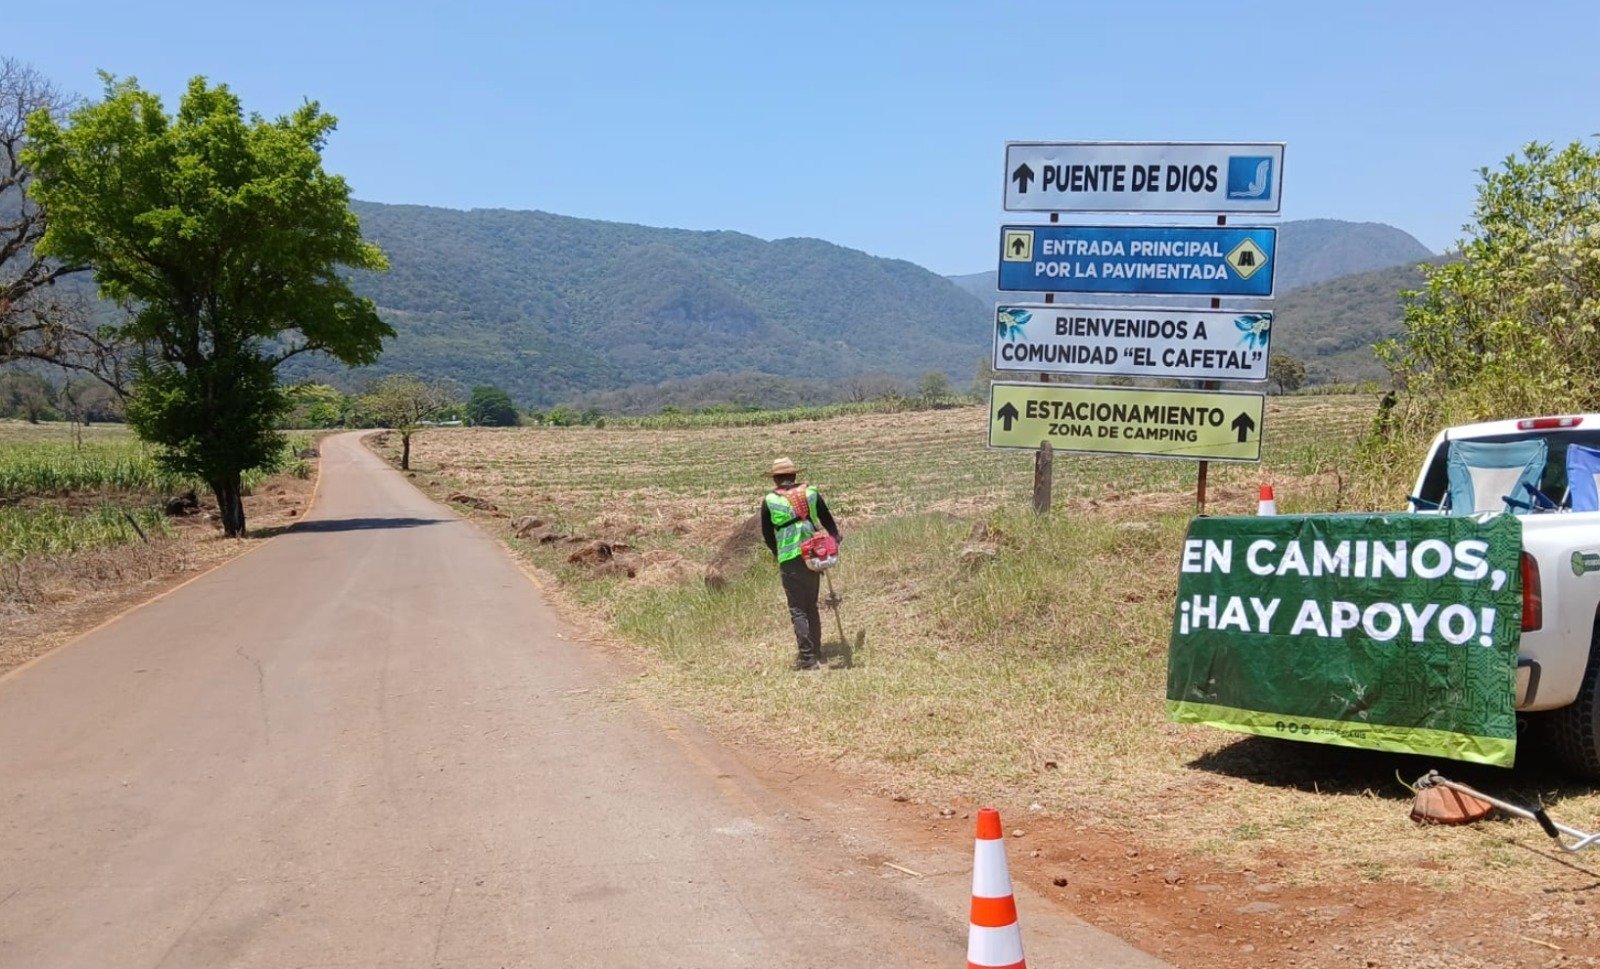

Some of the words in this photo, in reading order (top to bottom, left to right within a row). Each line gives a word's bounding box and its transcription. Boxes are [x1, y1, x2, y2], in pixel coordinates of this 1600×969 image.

[1042, 165, 1125, 192] PUENTE
[1131, 165, 1160, 192] DE
[1166, 165, 1218, 193] DIOS
[1043, 239, 1125, 256] ENTRADA
[1130, 241, 1223, 257] PRINCIPAL
[1035, 263, 1071, 278] POR
[1075, 263, 1097, 278] LA
[1102, 263, 1228, 280] PAVIMENTADA
[1056, 317, 1188, 339] BIENVENIDOS
[1193, 321, 1207, 340] A
[1002, 344, 1118, 365] COMUNIDAD
[1124, 350, 1156, 366] “EL
[1162, 350, 1262, 370] CAFETAL”
[1026, 400, 1224, 427] ESTACIONAMIENTO
[1048, 423, 1092, 438] ZONA
[1097, 425, 1119, 439] DE
[1123, 426, 1198, 442] CAMPING
[1181, 539, 1233, 573] EN
[1246, 538, 1506, 591] CAMINOS,
[1180, 595, 1281, 635] ¡HAY
[1290, 599, 1496, 647] APOYO!
